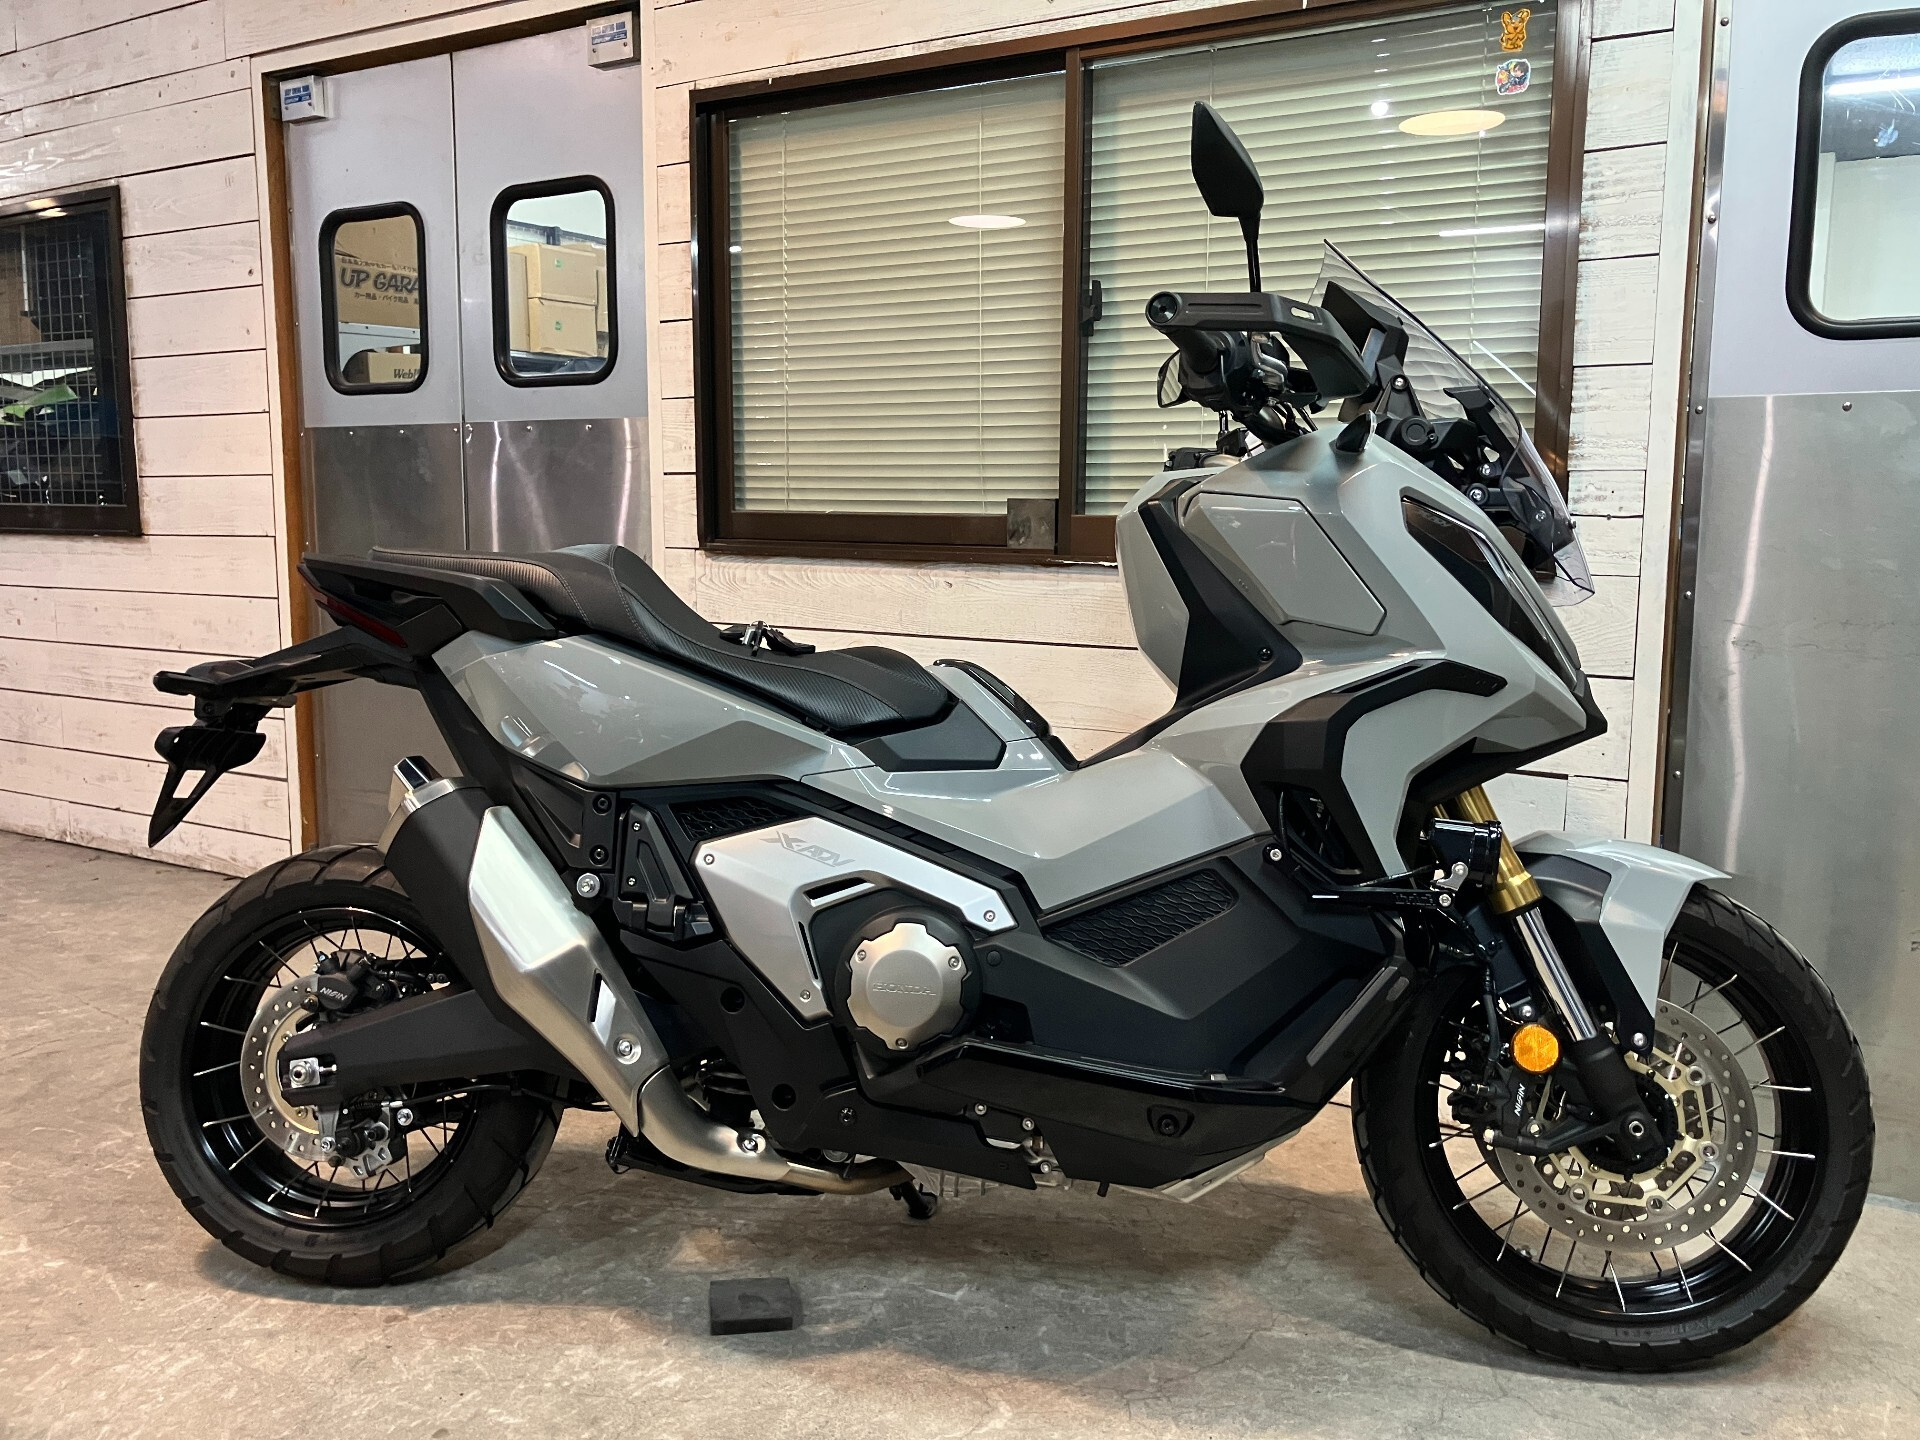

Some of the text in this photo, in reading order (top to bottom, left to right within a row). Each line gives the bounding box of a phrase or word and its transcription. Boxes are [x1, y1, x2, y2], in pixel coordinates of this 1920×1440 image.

[341, 267, 370, 287] UP
[759, 831, 855, 867] X-ADV
[872, 982, 937, 996] HONDA
